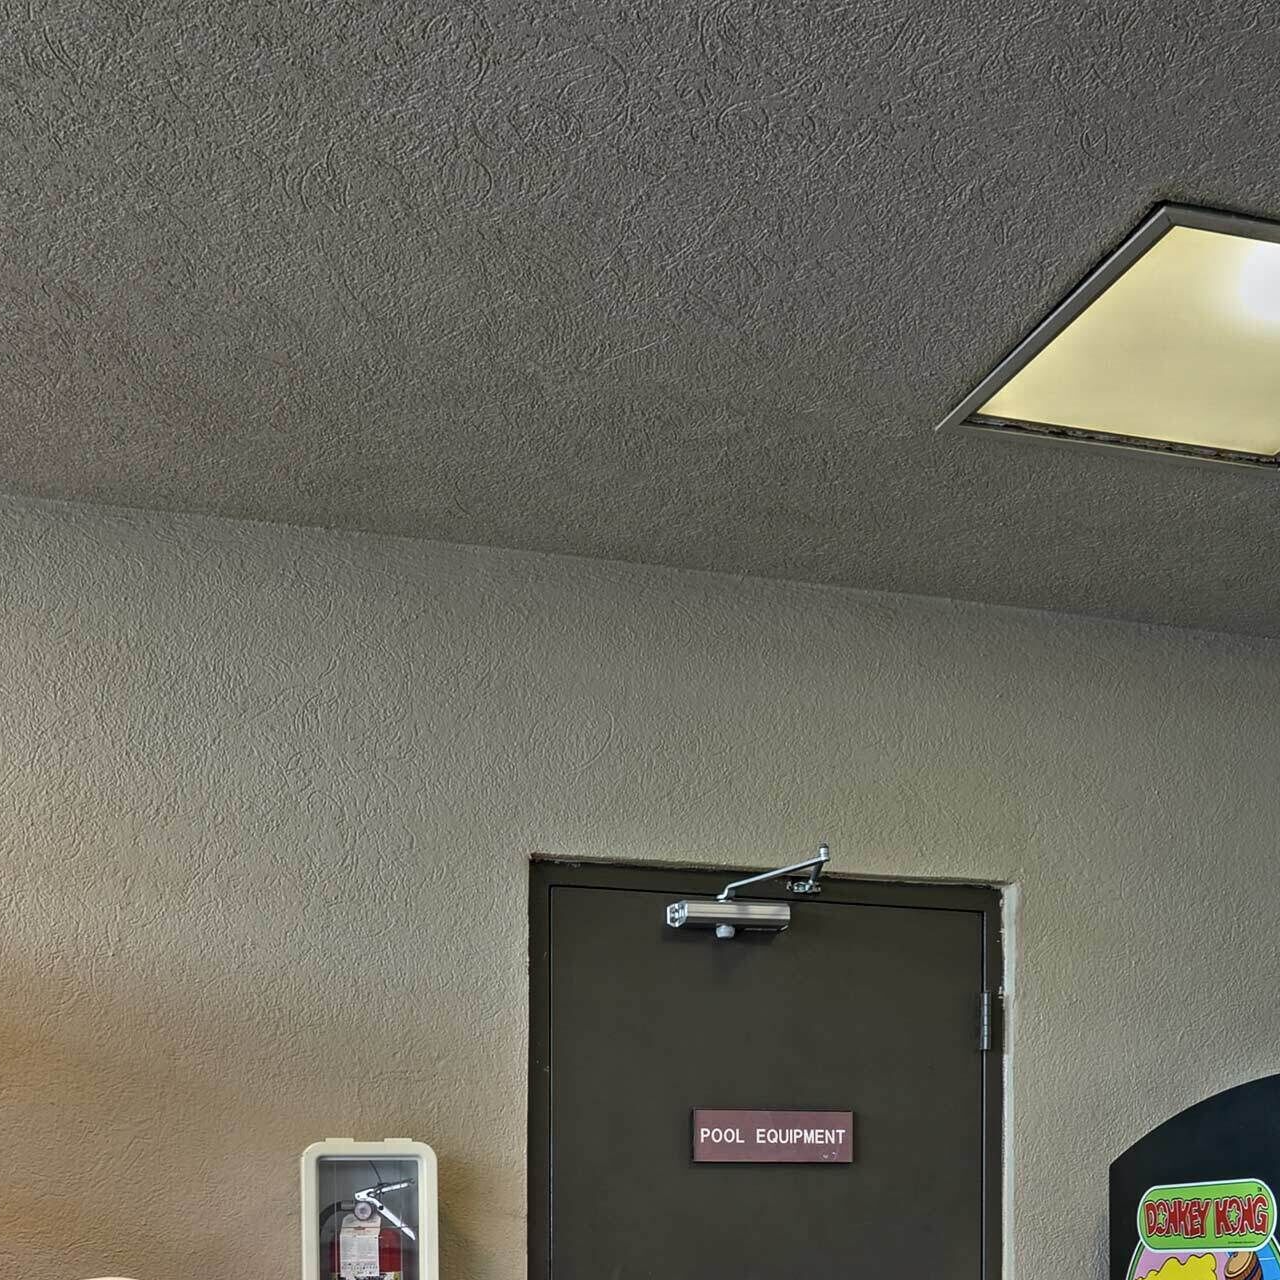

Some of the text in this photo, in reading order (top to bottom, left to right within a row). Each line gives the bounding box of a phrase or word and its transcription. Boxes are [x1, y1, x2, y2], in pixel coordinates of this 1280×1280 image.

[700, 1128, 846, 1145] POOL EQUIPMENT
[1143, 1194, 1269, 1239] DONKEY KONG
